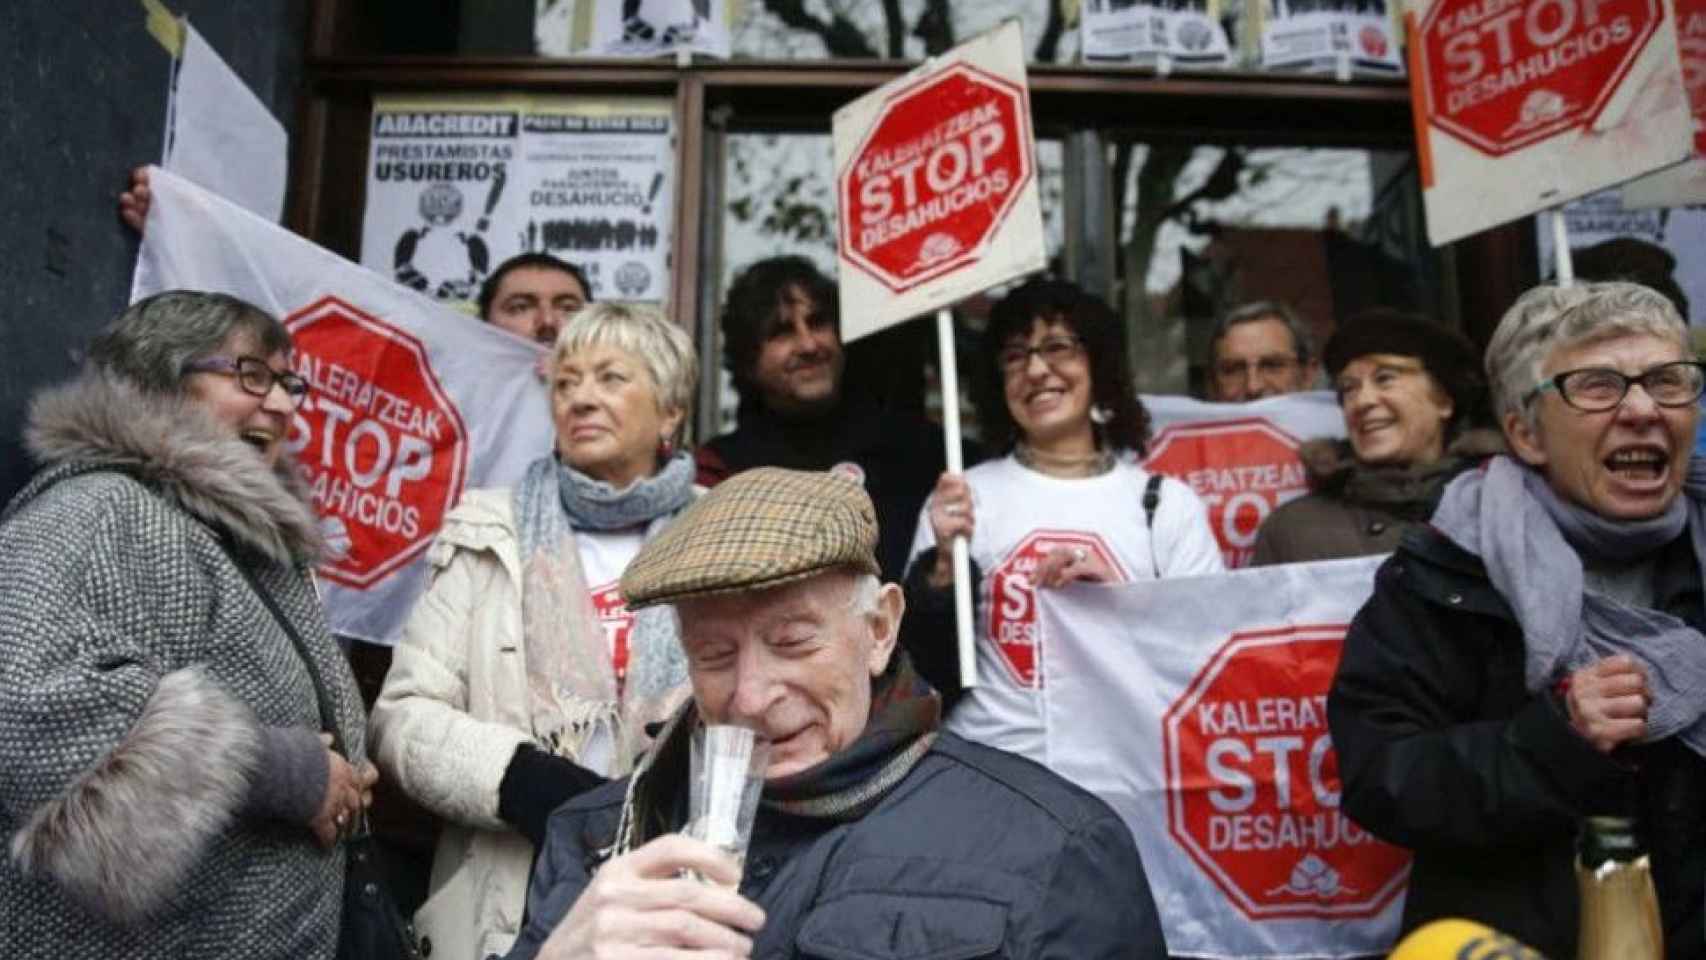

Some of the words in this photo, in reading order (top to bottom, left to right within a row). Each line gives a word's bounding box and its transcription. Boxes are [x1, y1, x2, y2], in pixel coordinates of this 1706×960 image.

[1446, 16, 1632, 115] DESAHUCIOS
[376, 144, 513, 161] PRESTAMISTAS
[378, 114, 511, 134] ABACREDIT
[858, 98, 1002, 178] KALERATZEAK
[860, 121, 1005, 226] STOP
[860, 167, 1009, 252] DESAHUCIOS
[1209, 812, 1373, 851] DESAHUC
